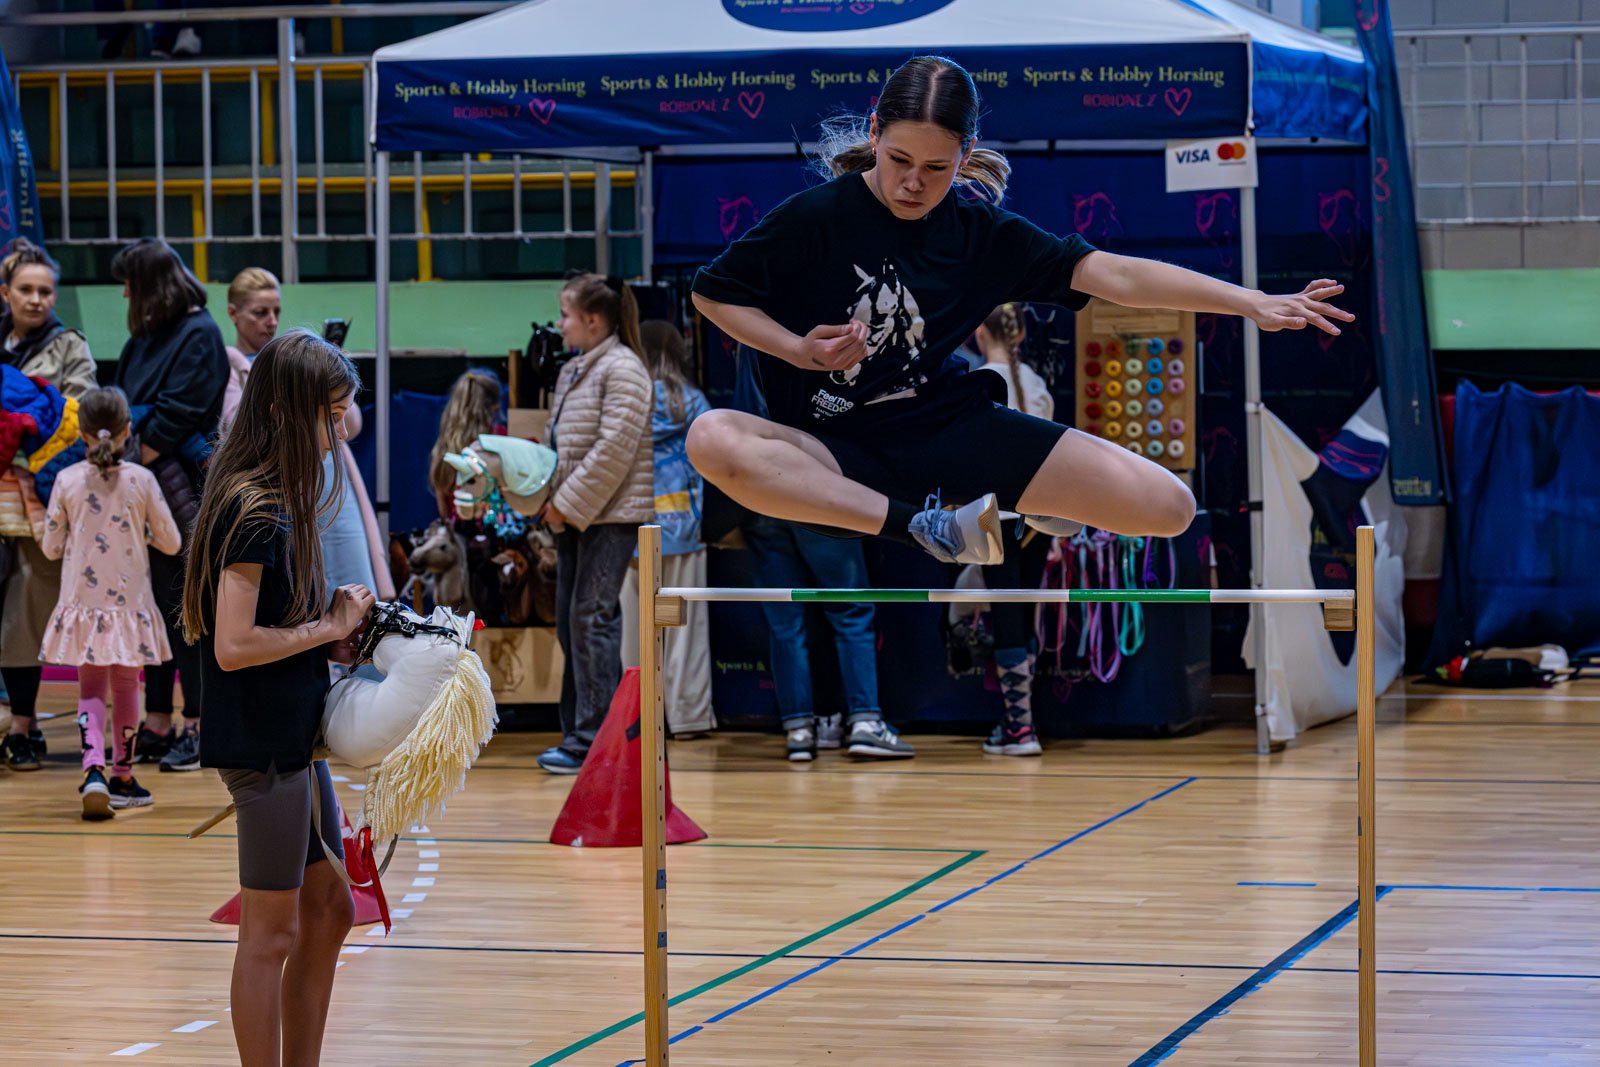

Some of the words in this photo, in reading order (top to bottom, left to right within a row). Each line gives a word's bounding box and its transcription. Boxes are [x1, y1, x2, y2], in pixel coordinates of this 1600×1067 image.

[600, 75, 651, 96] Sports
[656, 75, 669, 89] &
[674, 71, 727, 92] Hobby
[731, 70, 796, 91] Horsing
[810, 69, 862, 89] Sports
[866, 69, 880, 84] &
[1023, 67, 1076, 87] Sports
[1080, 67, 1094, 82] &
[1100, 65, 1154, 87] Hobby
[1158, 66, 1225, 88] Horsing
[394, 82, 446, 103] Sports
[450, 82, 462, 95] &
[466, 78, 519, 99] Hobby
[523, 78, 587, 98] Horsing
[1175, 148, 1211, 165] VISA
[818, 388, 838, 403] Feel
[836, 397, 855, 408] The
